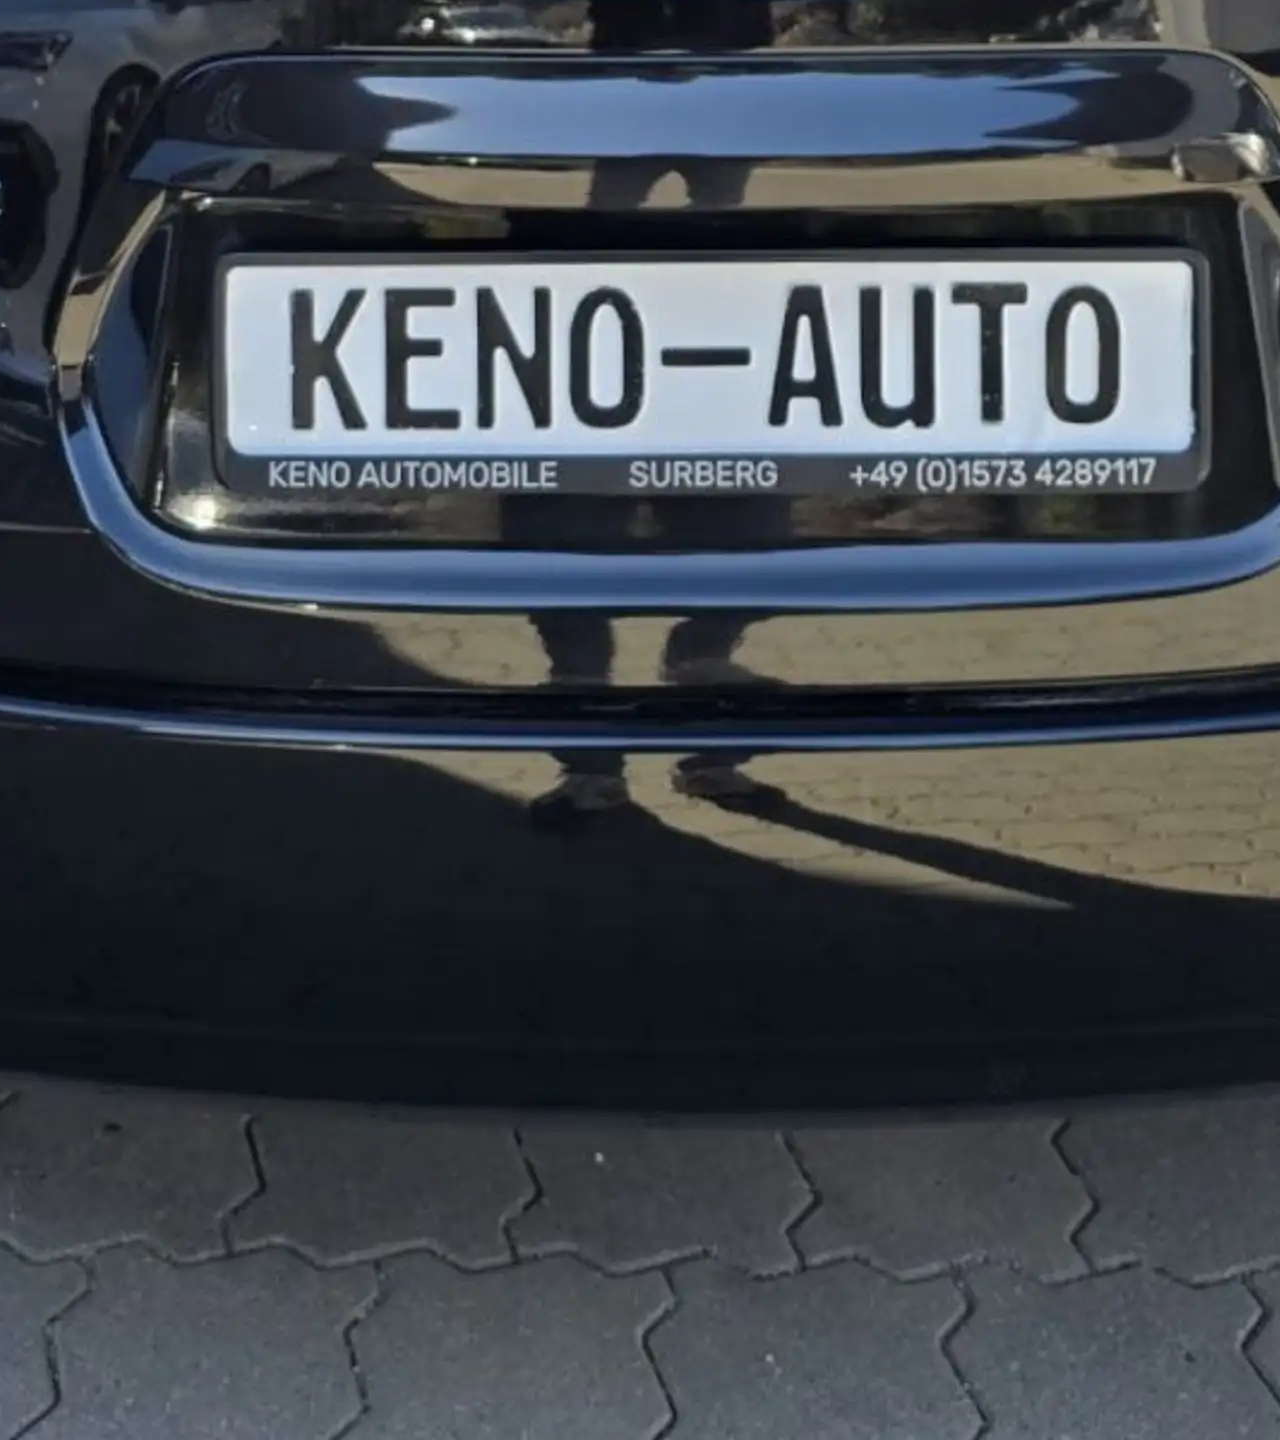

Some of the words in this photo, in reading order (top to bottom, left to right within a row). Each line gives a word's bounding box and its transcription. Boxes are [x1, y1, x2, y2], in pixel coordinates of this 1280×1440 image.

[267, 460, 351, 490] KENO
[356, 460, 559, 489] AUTOMOBILE
[627, 460, 779, 488] SURBERG
[849, 460, 909, 488] +49
[916, 458, 1028, 493] (0)1573
[1033, 457, 1157, 487] 4289117
